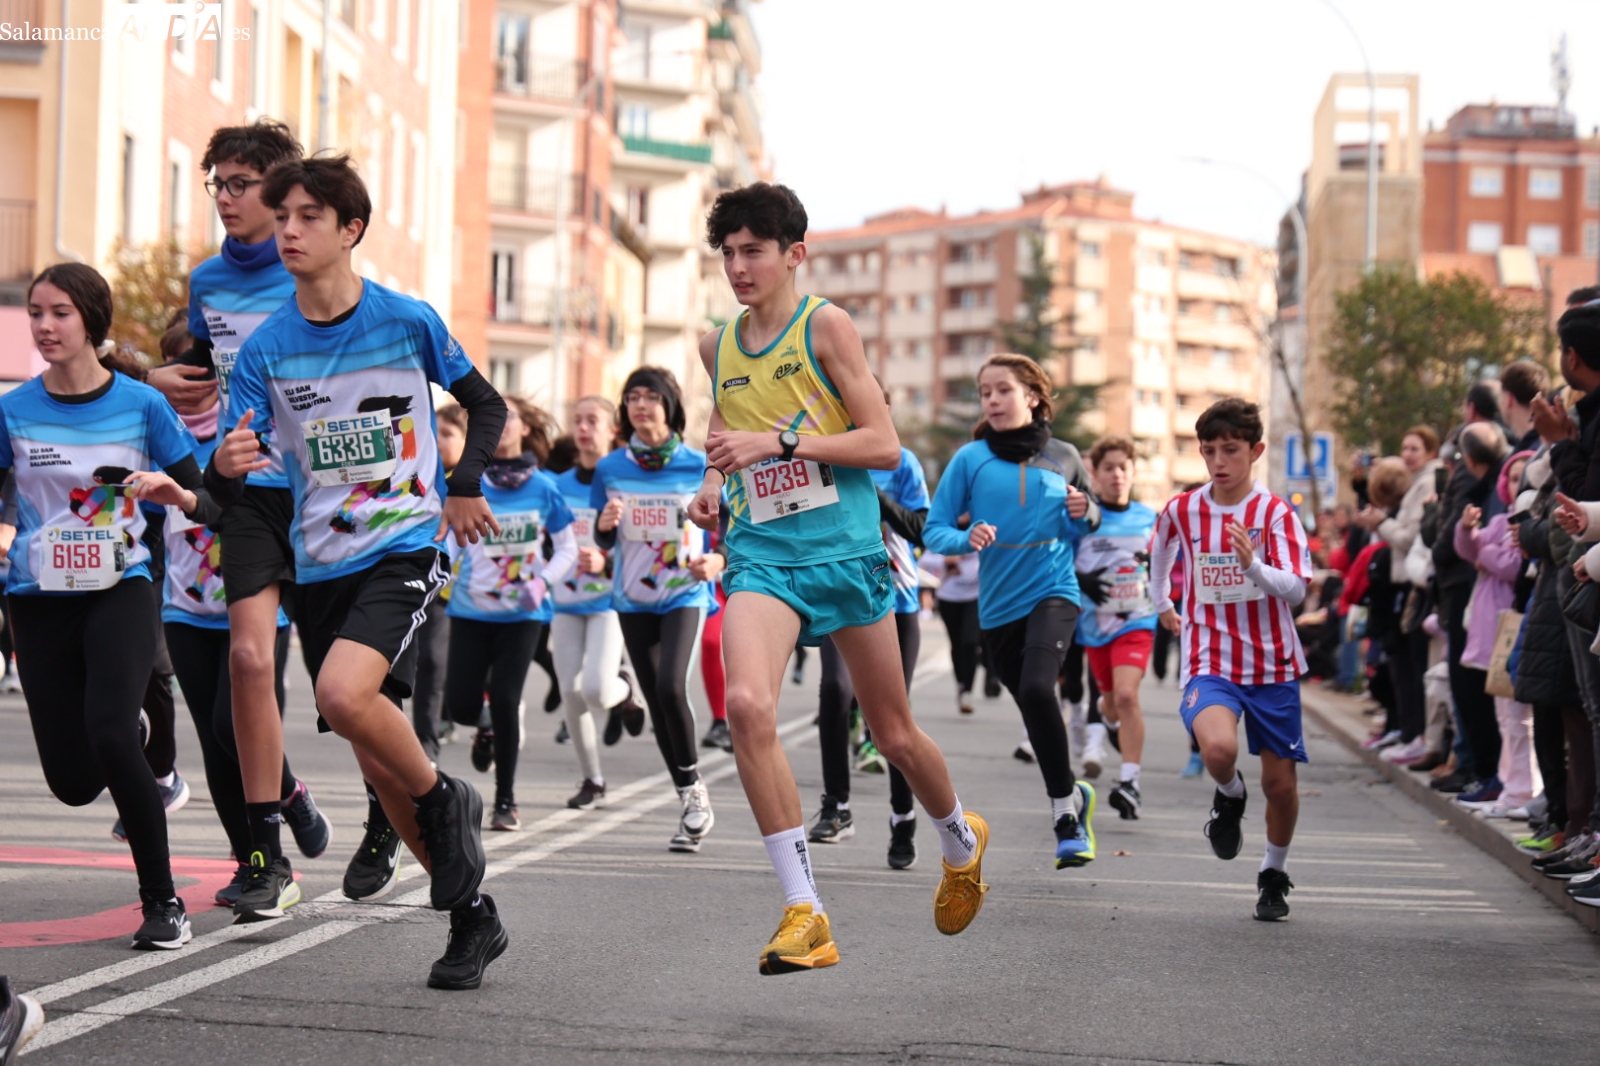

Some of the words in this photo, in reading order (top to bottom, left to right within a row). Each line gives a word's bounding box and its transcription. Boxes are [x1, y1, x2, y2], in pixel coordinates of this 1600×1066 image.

[295, 384, 312, 394] SAN
[327, 415, 384, 433] SETEL
[317, 431, 375, 465] 6336
[30, 459, 72, 467] SALMANTINA
[753, 459, 810, 499] 6239
[632, 508, 668, 526] 6156
[61, 530, 115, 541] SETEL
[53, 544, 101, 569] 6158
[1208, 555, 1240, 565] SET
[1201, 566, 1245, 587] 6255
